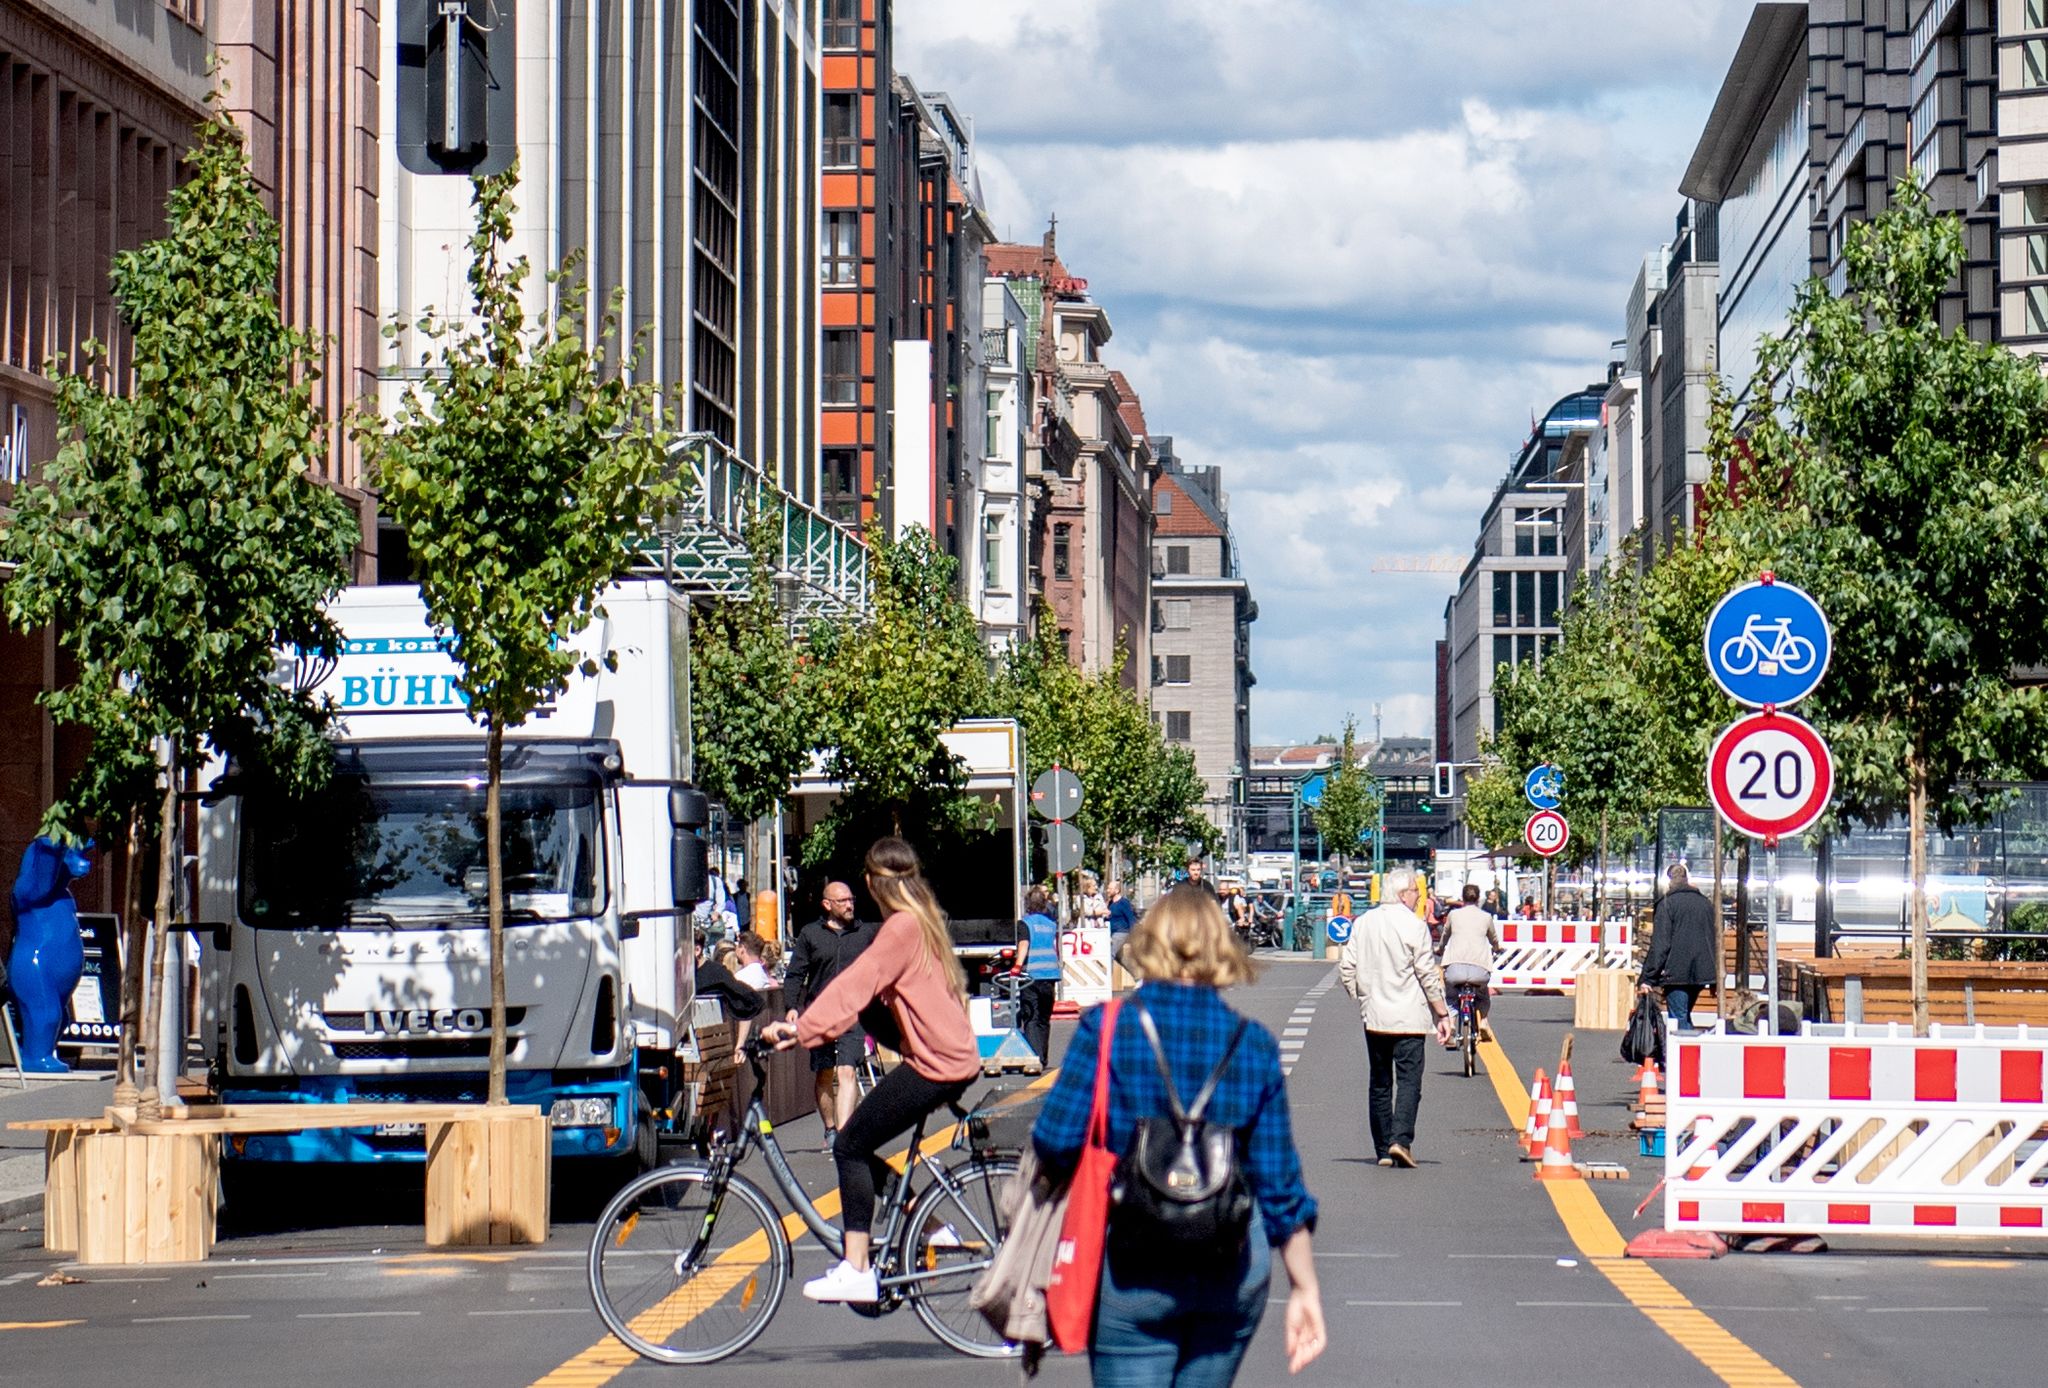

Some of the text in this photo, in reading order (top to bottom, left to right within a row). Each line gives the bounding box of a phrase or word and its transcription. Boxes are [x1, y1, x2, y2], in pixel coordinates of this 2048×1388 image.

[341, 666, 471, 706] BÜHN
[1739, 750, 1802, 799] 20
[1536, 823, 1558, 841] 20
[364, 1008, 484, 1035] IVECO
